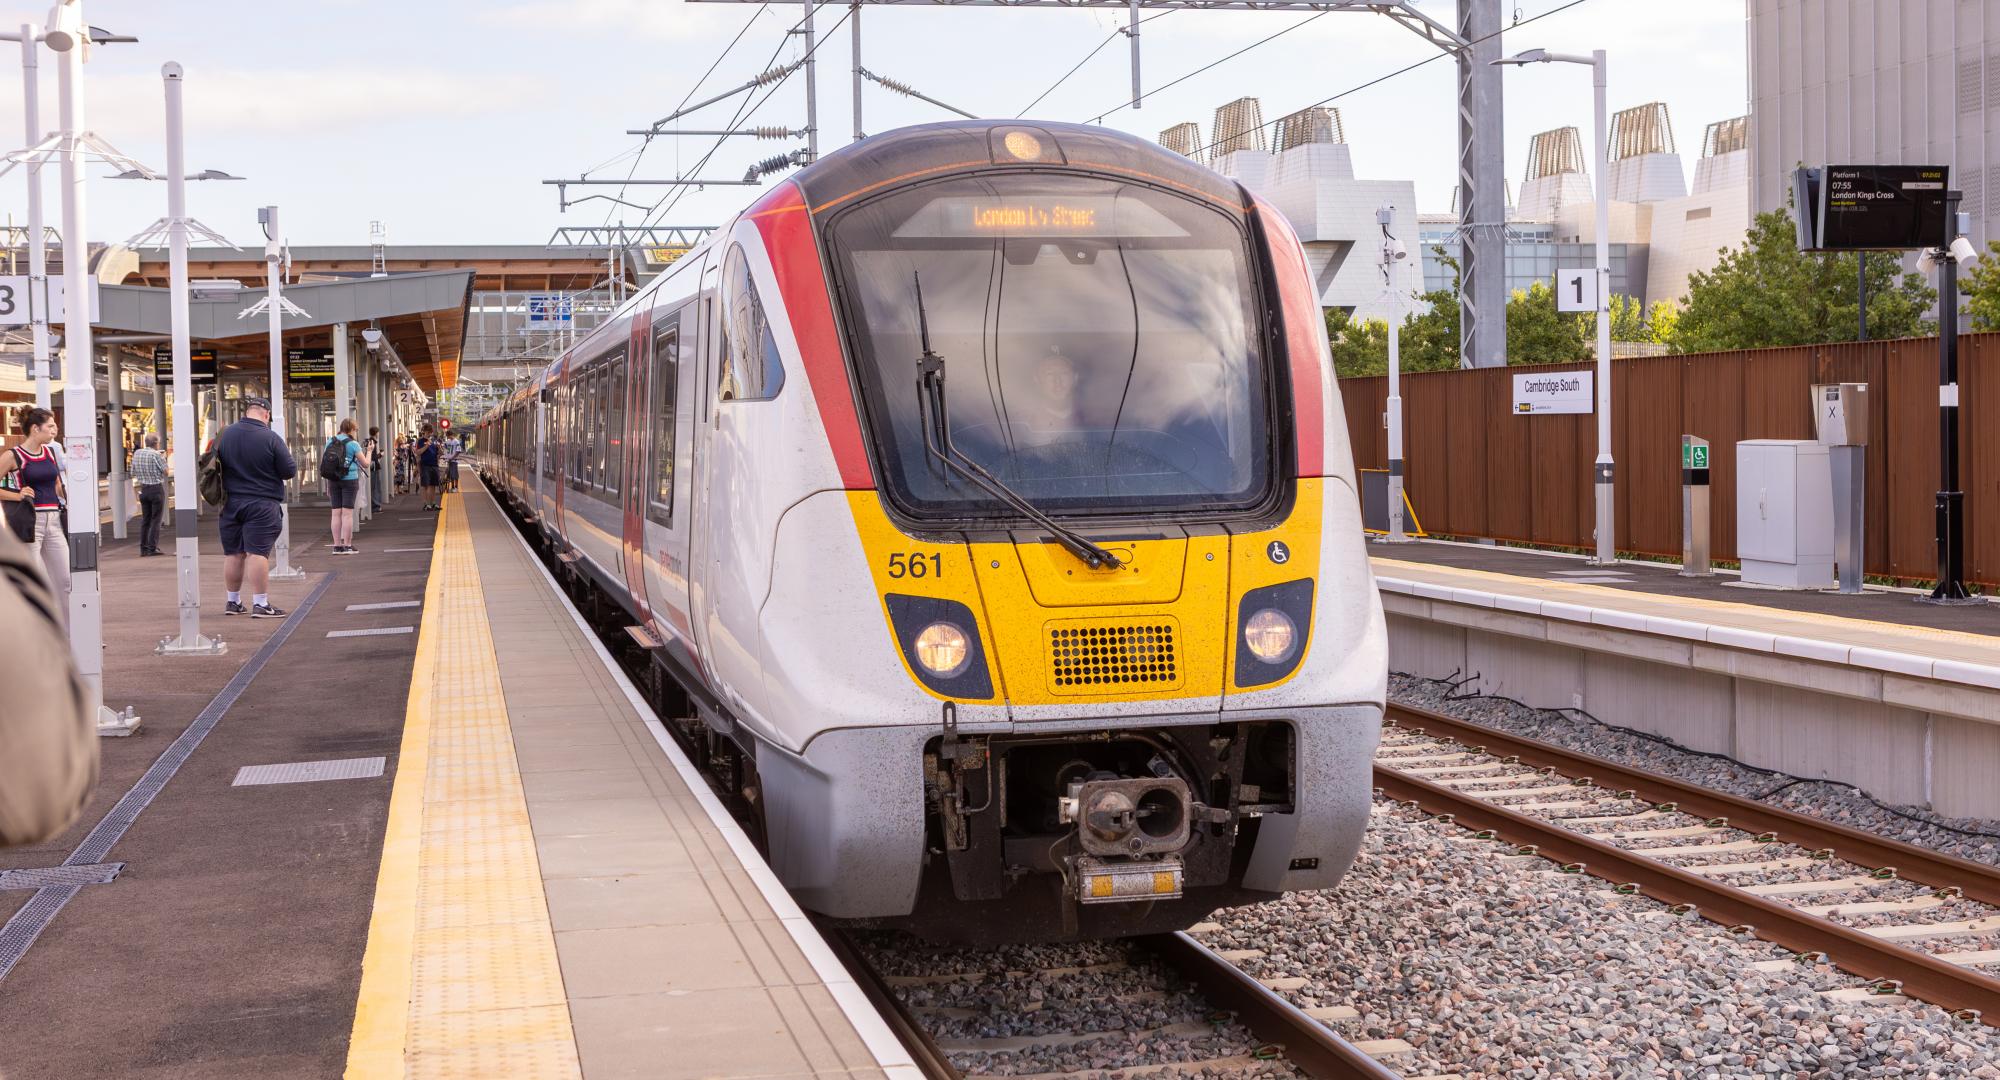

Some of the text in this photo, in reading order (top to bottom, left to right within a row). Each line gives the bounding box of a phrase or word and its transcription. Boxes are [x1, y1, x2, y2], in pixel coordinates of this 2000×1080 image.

[1832, 182, 1852, 190] 07:55
[1831, 191, 1895, 200] London Kings Cross
[974, 206, 1026, 226] London
[1571, 276, 1582, 304] 1
[0, 285, 15, 315] 3
[1524, 378, 1580, 395] Cambridge South
[400, 392, 408, 403] 2
[415, 406, 421, 414] 2
[1828, 405, 1836, 419] X
[888, 552, 941, 578] 561
